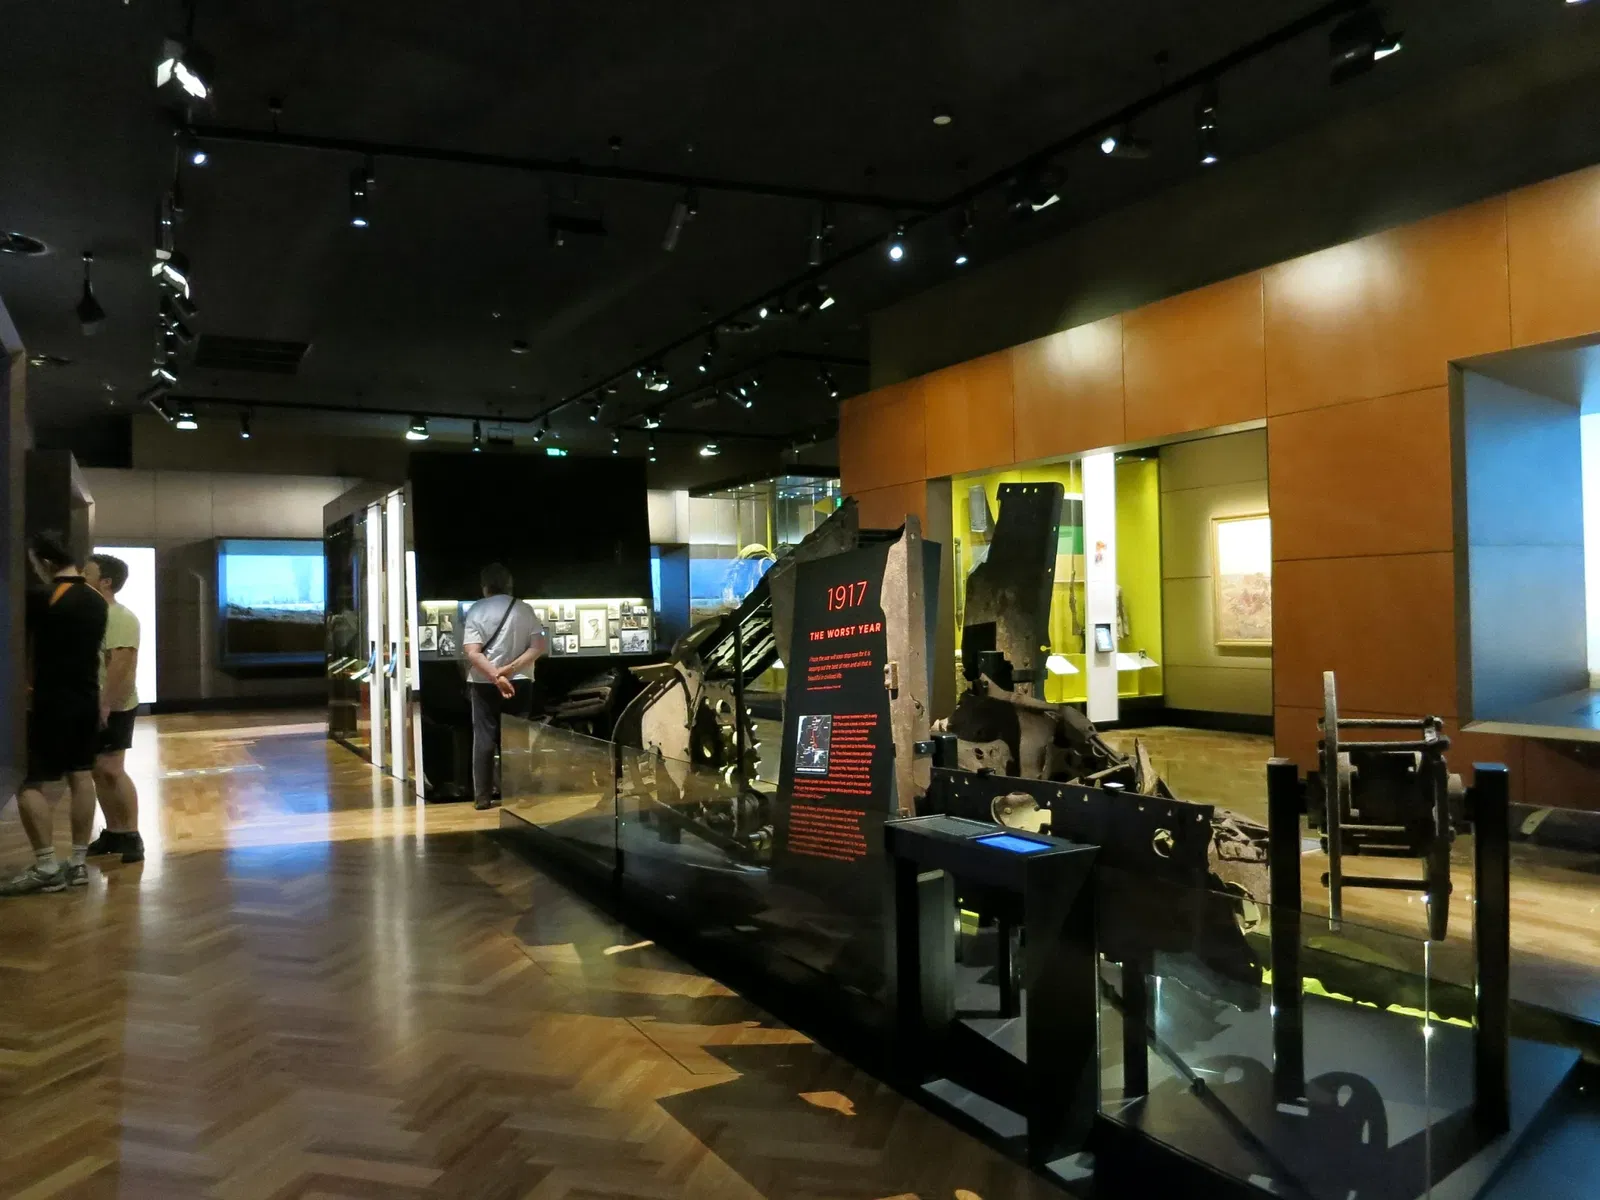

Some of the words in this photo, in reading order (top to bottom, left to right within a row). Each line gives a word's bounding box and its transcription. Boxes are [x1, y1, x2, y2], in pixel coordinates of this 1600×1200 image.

[827, 581, 868, 611] 1917
[810, 631, 824, 641] THE
[827, 627, 855, 639] WORST
[858, 622, 881, 634] YEAR
